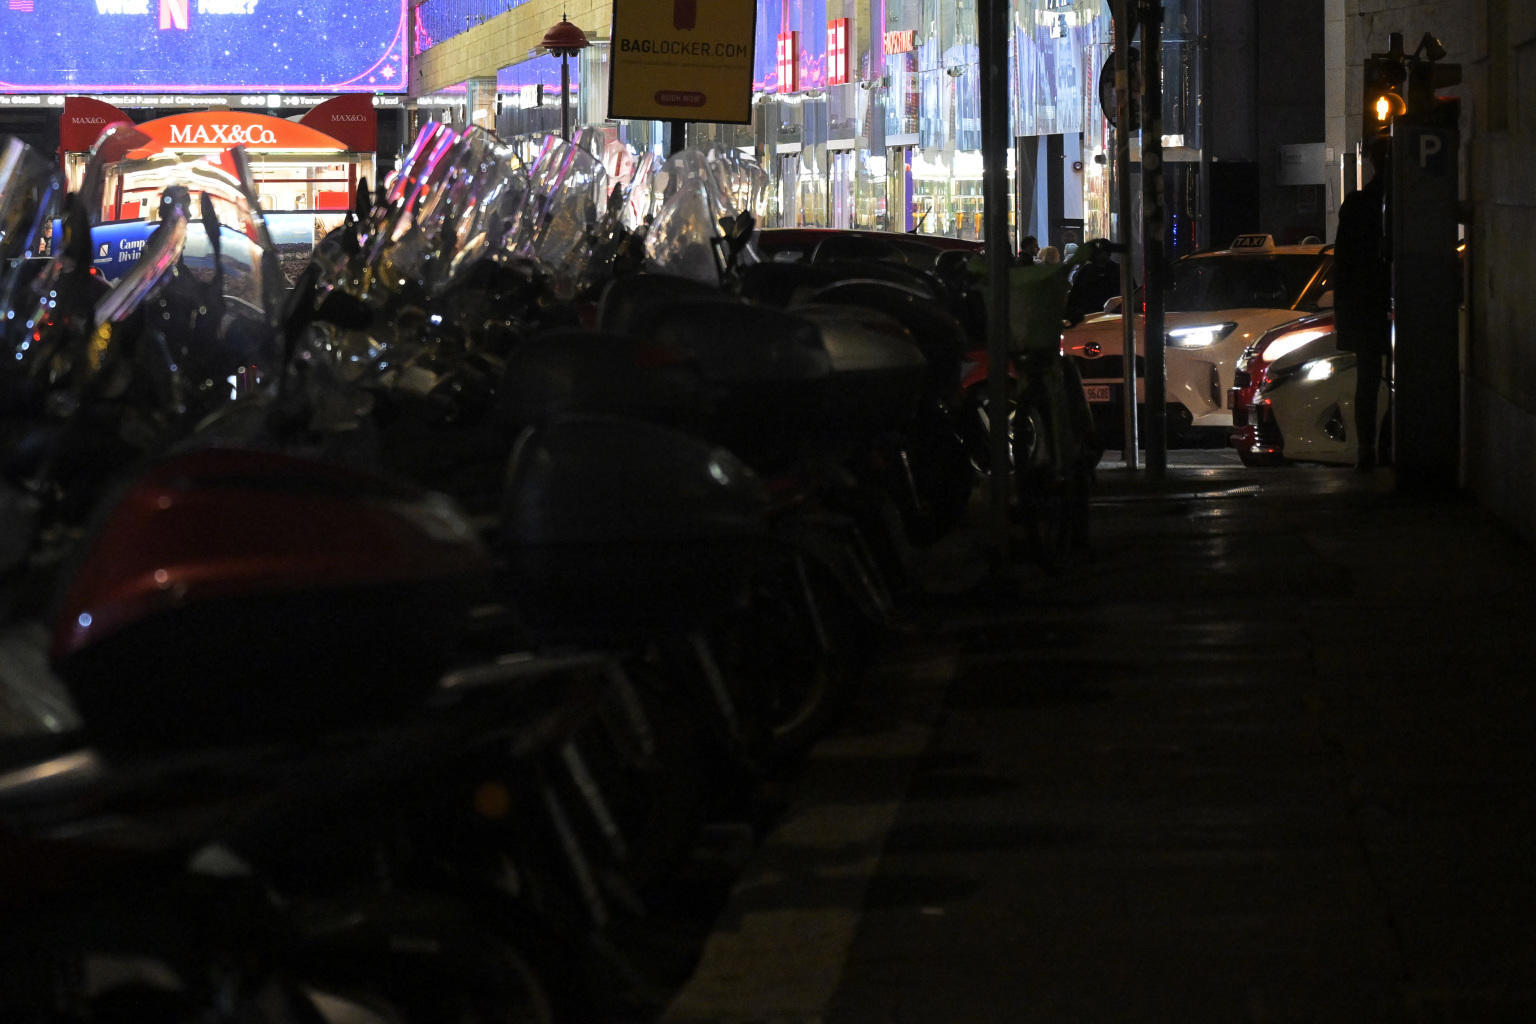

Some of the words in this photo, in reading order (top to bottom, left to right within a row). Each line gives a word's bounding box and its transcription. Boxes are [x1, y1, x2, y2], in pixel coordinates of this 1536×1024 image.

[621, 38, 748, 58] BAGLOCKER.COM
[170, 124, 277, 144] MAX&Co.
[1419, 134, 1442, 168] P
[119, 238, 146, 251] Camp
[118, 250, 141, 263] Divin
